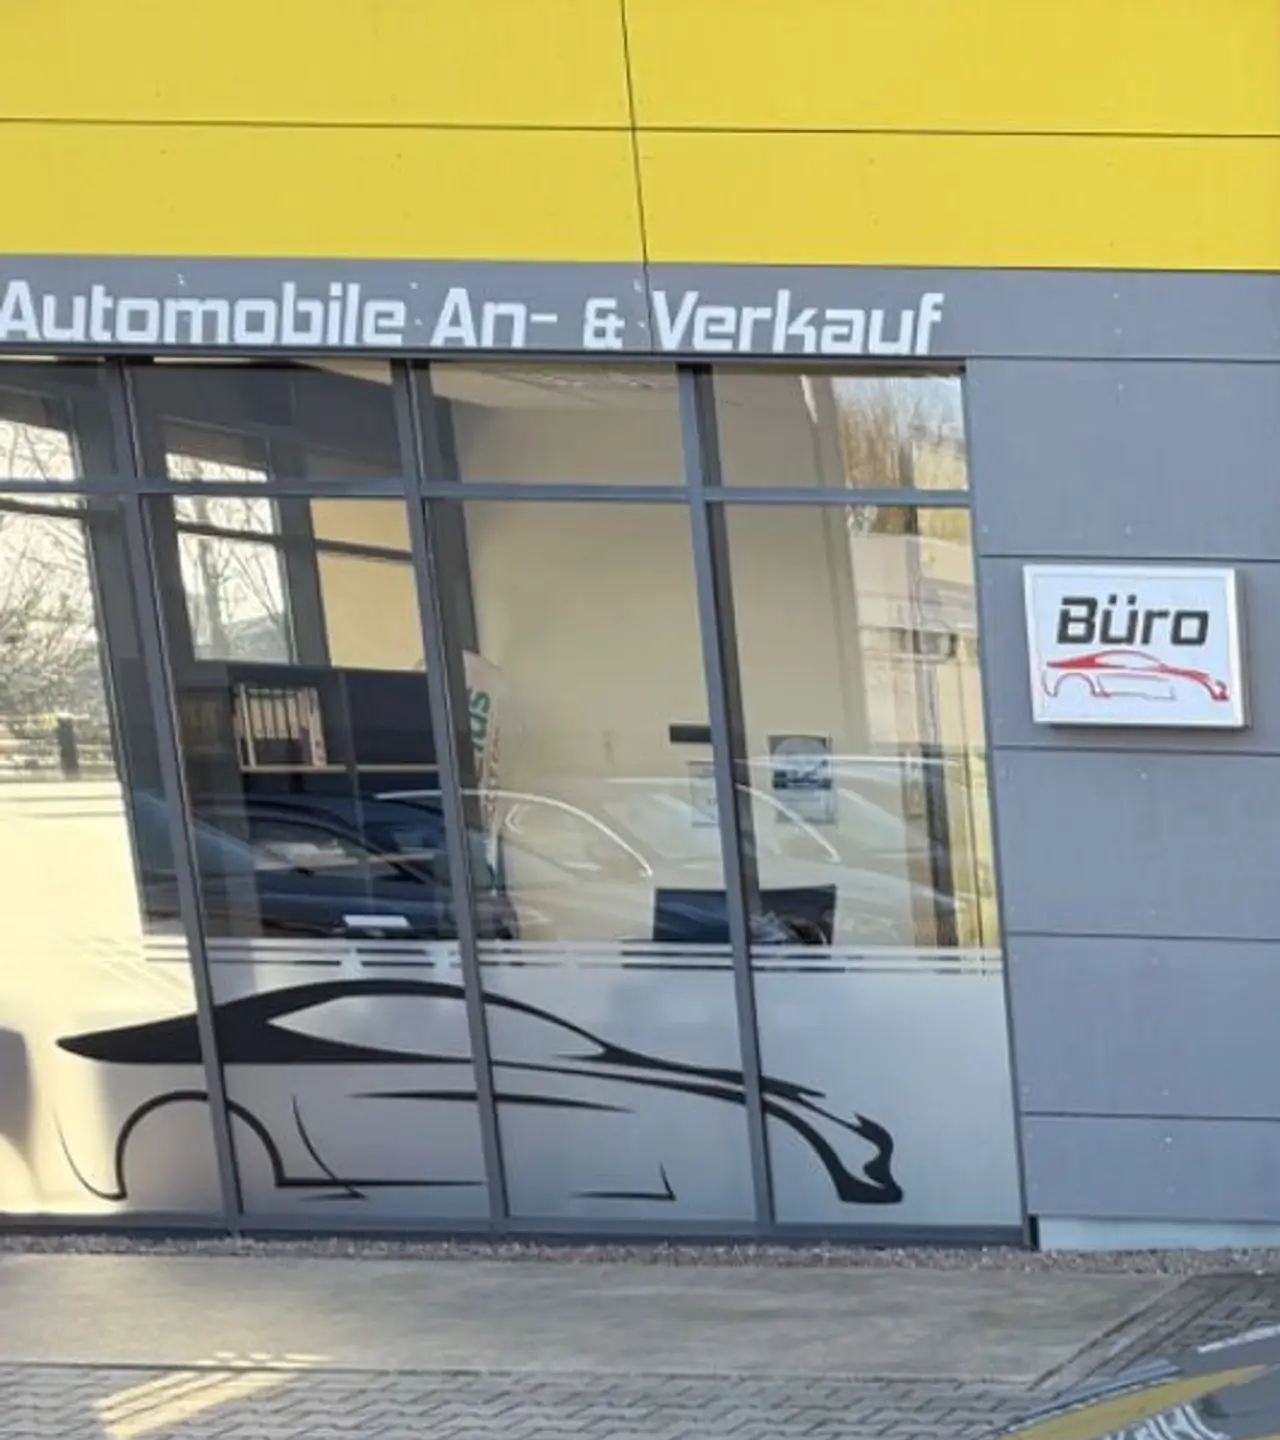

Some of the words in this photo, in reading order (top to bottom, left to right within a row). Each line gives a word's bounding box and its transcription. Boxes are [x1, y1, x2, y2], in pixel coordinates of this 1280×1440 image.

[0, 279, 407, 345] Automobile
[430, 287, 558, 348] An-
[583, 297, 625, 349] &
[651, 289, 945, 355] Verkauf
[1056, 594, 1210, 646] Büro
